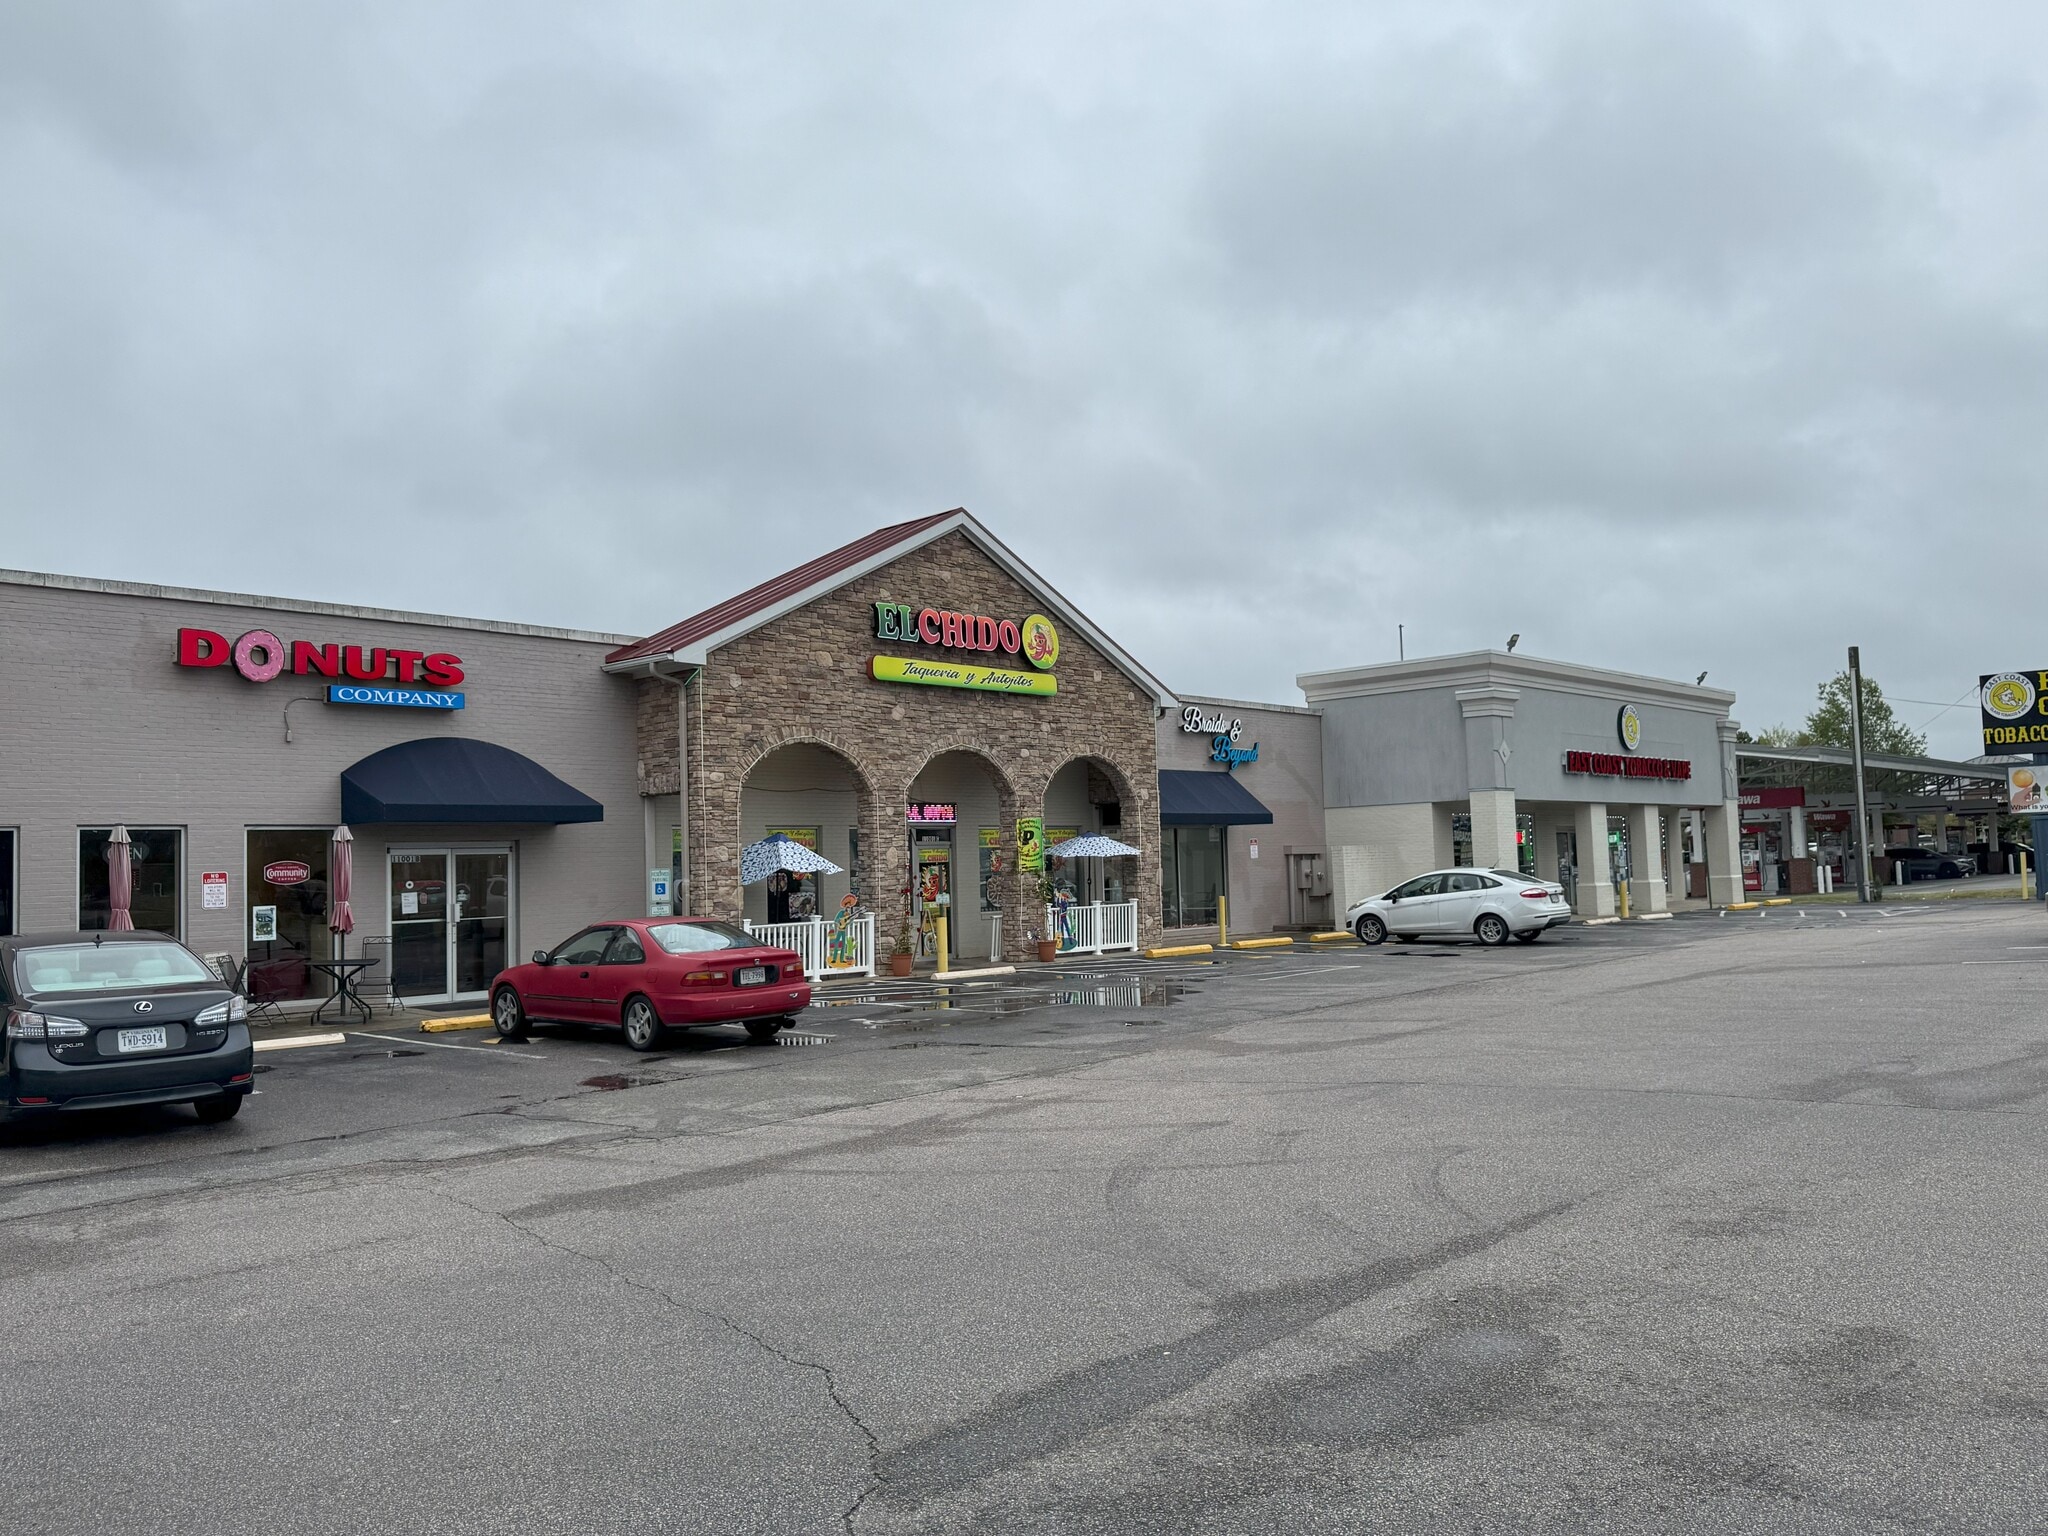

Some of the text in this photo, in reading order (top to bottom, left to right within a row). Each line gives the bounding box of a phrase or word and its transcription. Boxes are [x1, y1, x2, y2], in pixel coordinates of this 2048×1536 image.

[177, 627, 465, 686] DONUTS
[902, 662, 1034, 689] Taqueria y Antojitos
[1985, 675, 2003, 690] EAST
[2004, 674, 2030, 687] COAST
[338, 687, 458, 707] COMPANY
[1183, 706, 1242, 742] Braids &
[1213, 736, 1260, 771] Beyond
[1567, 750, 1592, 773] EAST
[1592, 753, 1622, 776] COAST
[1623, 756, 1662, 779] TOBACCO
[1670, 760, 1691, 780] VAPE
[1738, 795, 1760, 805] awa
[2011, 804, 2031, 813] What
[2032, 803, 2038, 812] is
[266, 868, 308, 879] Community
[121, 1033, 164, 1047] TWD-5914
